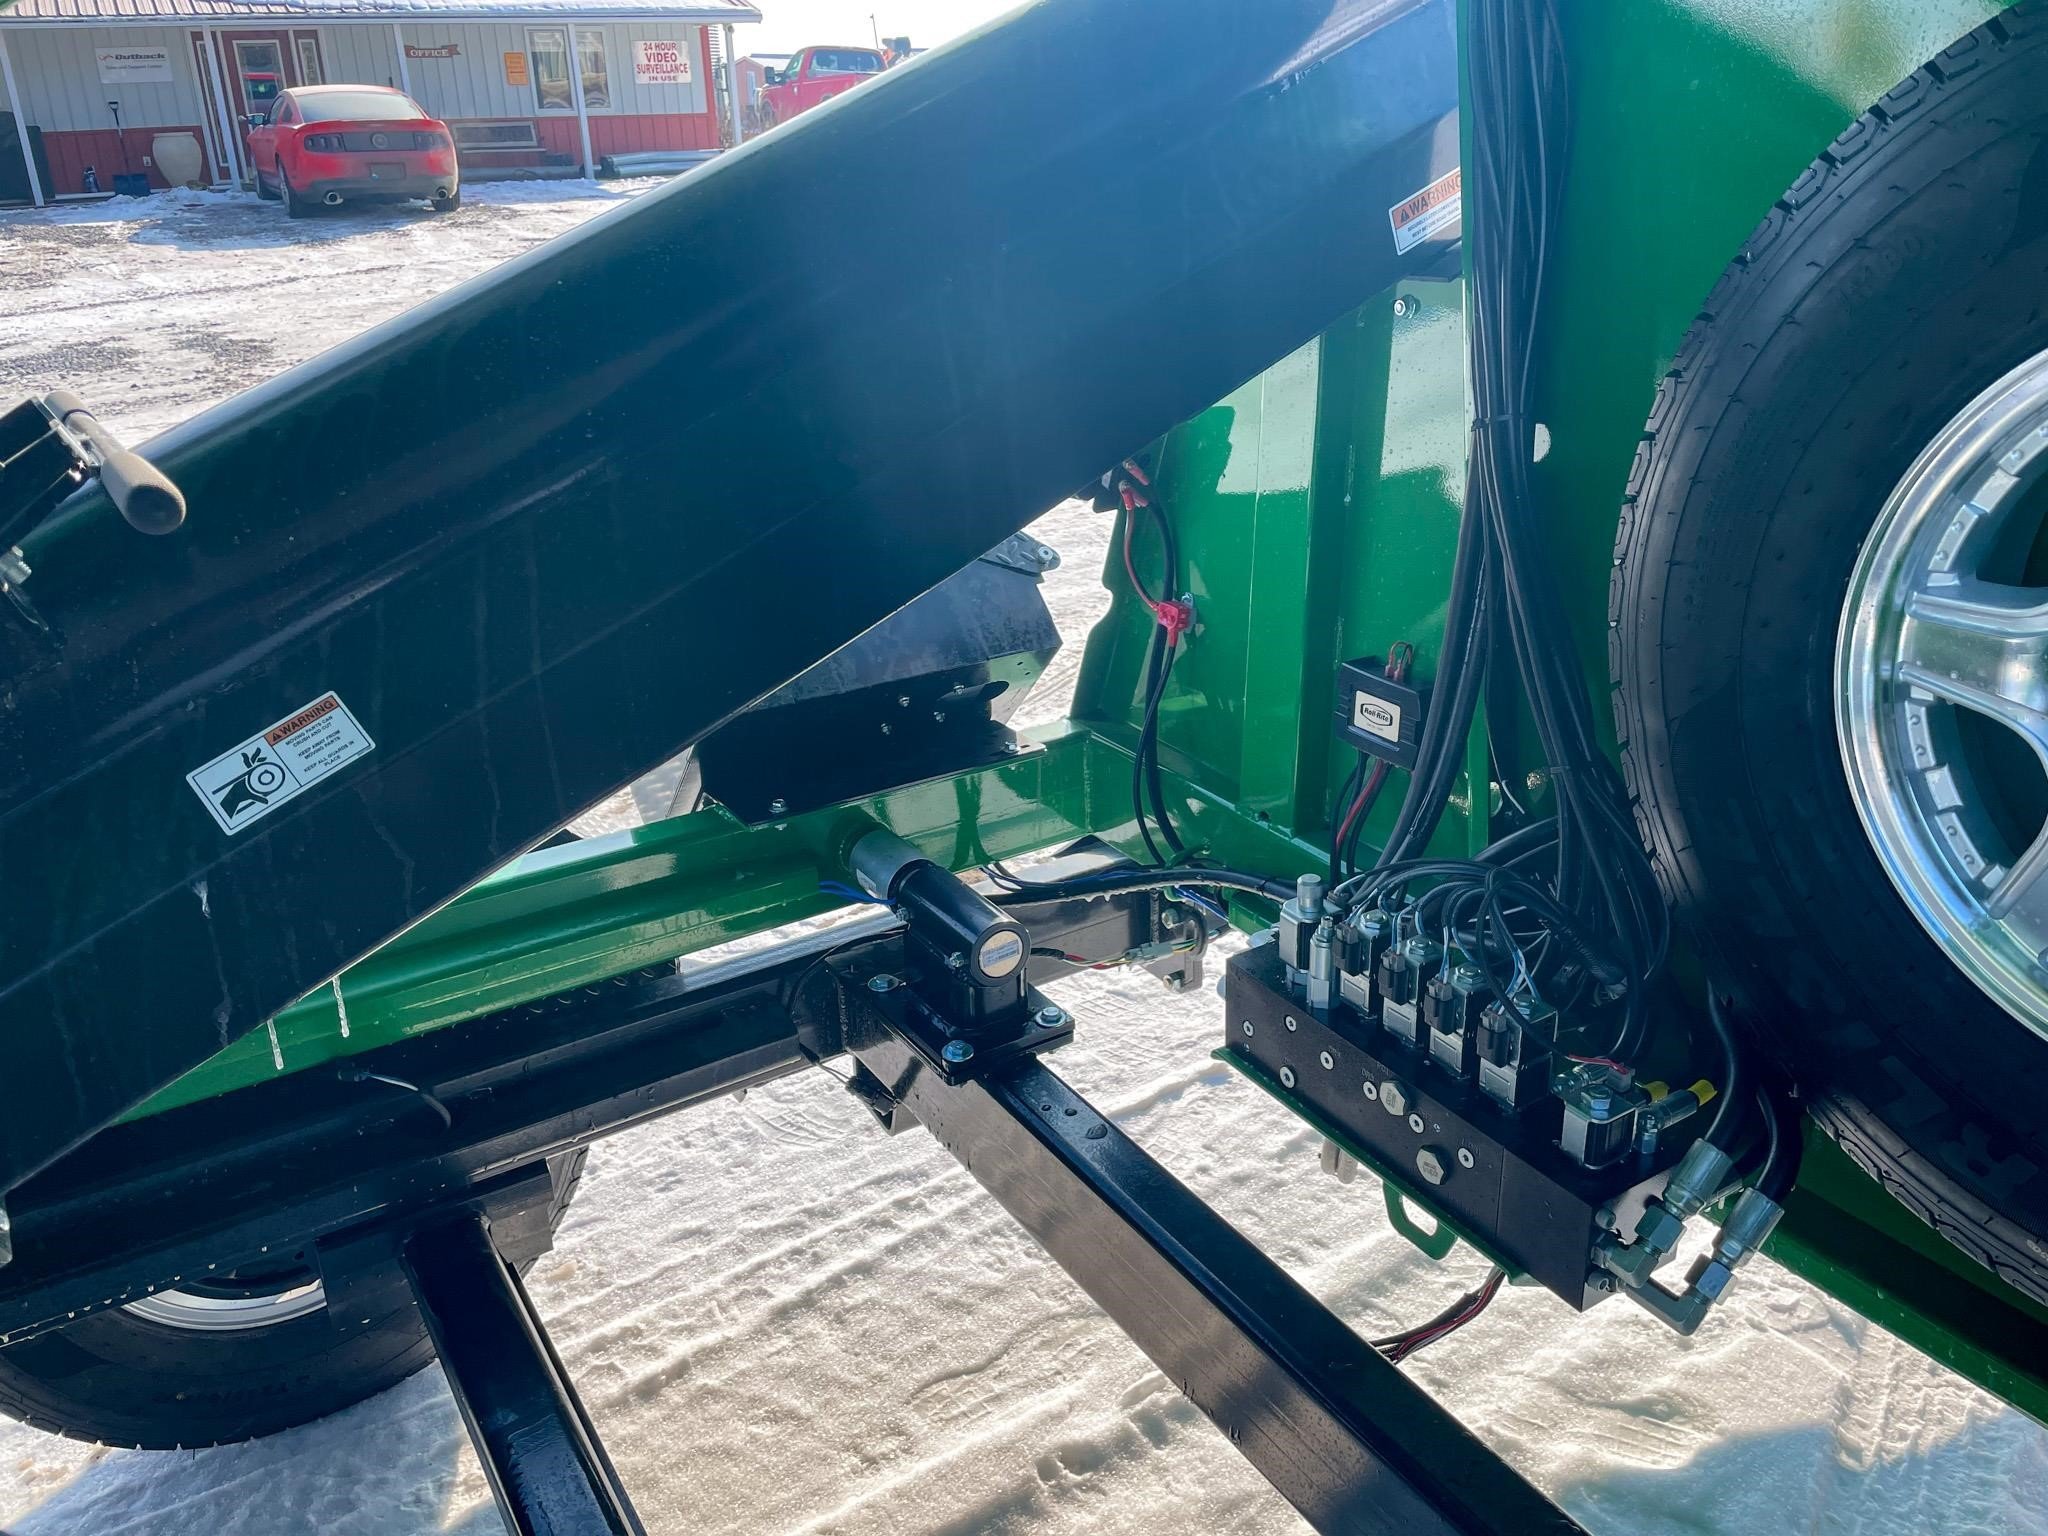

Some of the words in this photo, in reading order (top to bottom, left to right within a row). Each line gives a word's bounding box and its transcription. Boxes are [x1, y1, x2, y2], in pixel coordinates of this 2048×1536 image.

[643, 42, 653, 51] 24
[655, 42, 677, 51] HOUR
[410, 49, 449, 57] OFFICE
[645, 52, 678, 63] VIDEO
[636, 63, 688, 74] SURVEILLANCE
[280, 700, 334, 736] WARNING
[285, 732, 306, 746] MOVING
[305, 723, 322, 734] PARTS
[321, 715, 333, 725] CAN
[293, 735, 311, 748] CRUSH
[311, 728, 322, 738] AND
[321, 721, 333, 731] CUT
[298, 746, 312, 758] KEEP
